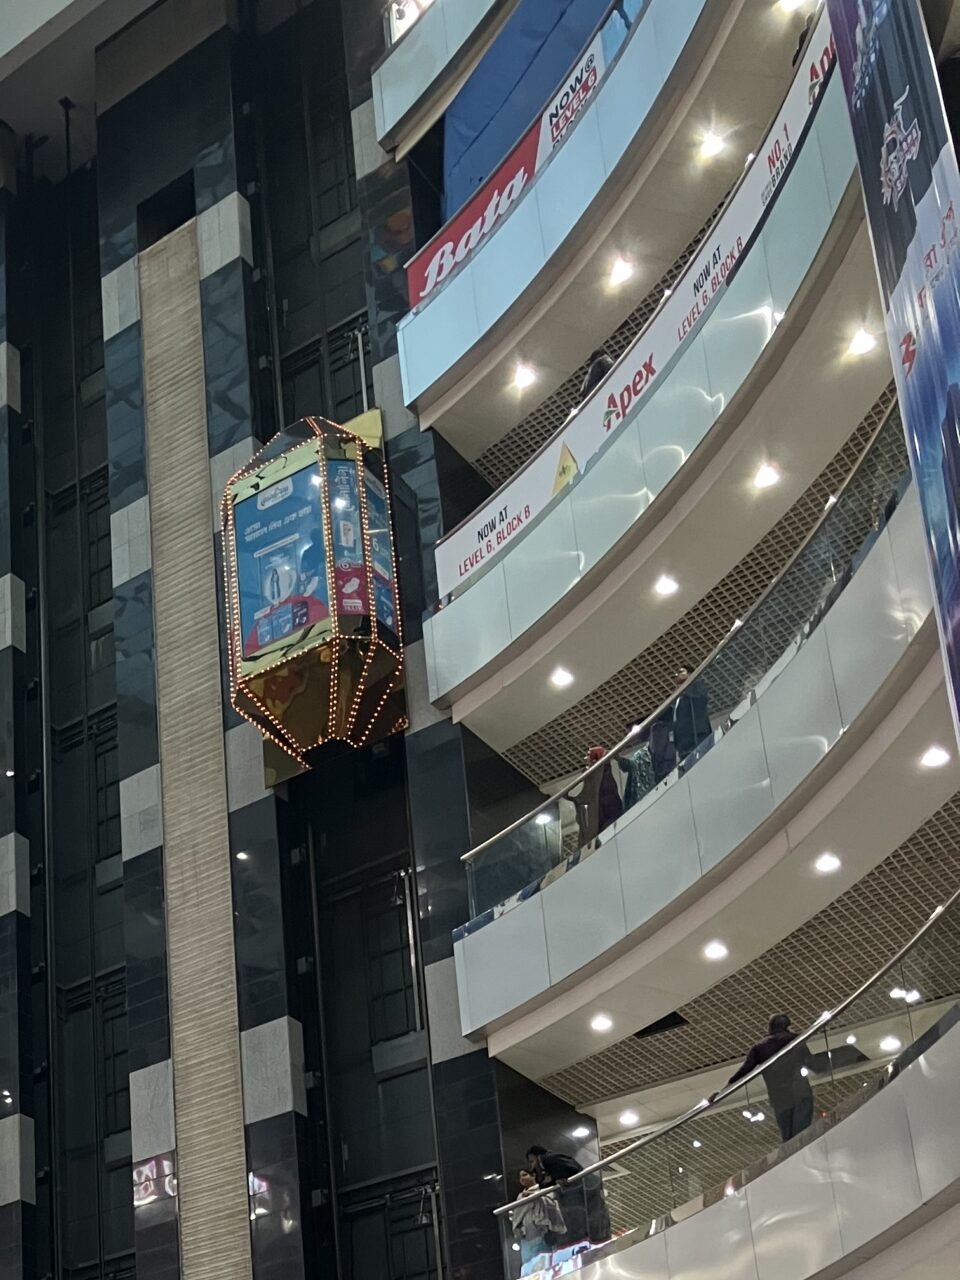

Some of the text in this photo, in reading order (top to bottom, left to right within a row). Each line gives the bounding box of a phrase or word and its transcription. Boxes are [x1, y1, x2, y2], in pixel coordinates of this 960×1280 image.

[550, 69, 584, 126] NOW
[552, 89, 587, 142] LEVEL
[587, 66, 597, 87] 6
[768, 122, 789, 175] NO. 1
[771, 143, 792, 187] BRAND
[420, 167, 528, 297] Bata
[678, 236, 743, 341] LEVEL BLOCK B
[693, 245, 722, 297] NOW AT
[603, 353, 656, 431] Apex
[458, 505, 531, 577] LEVEL BLOCK B
[477, 505, 508, 543] NOW AT
